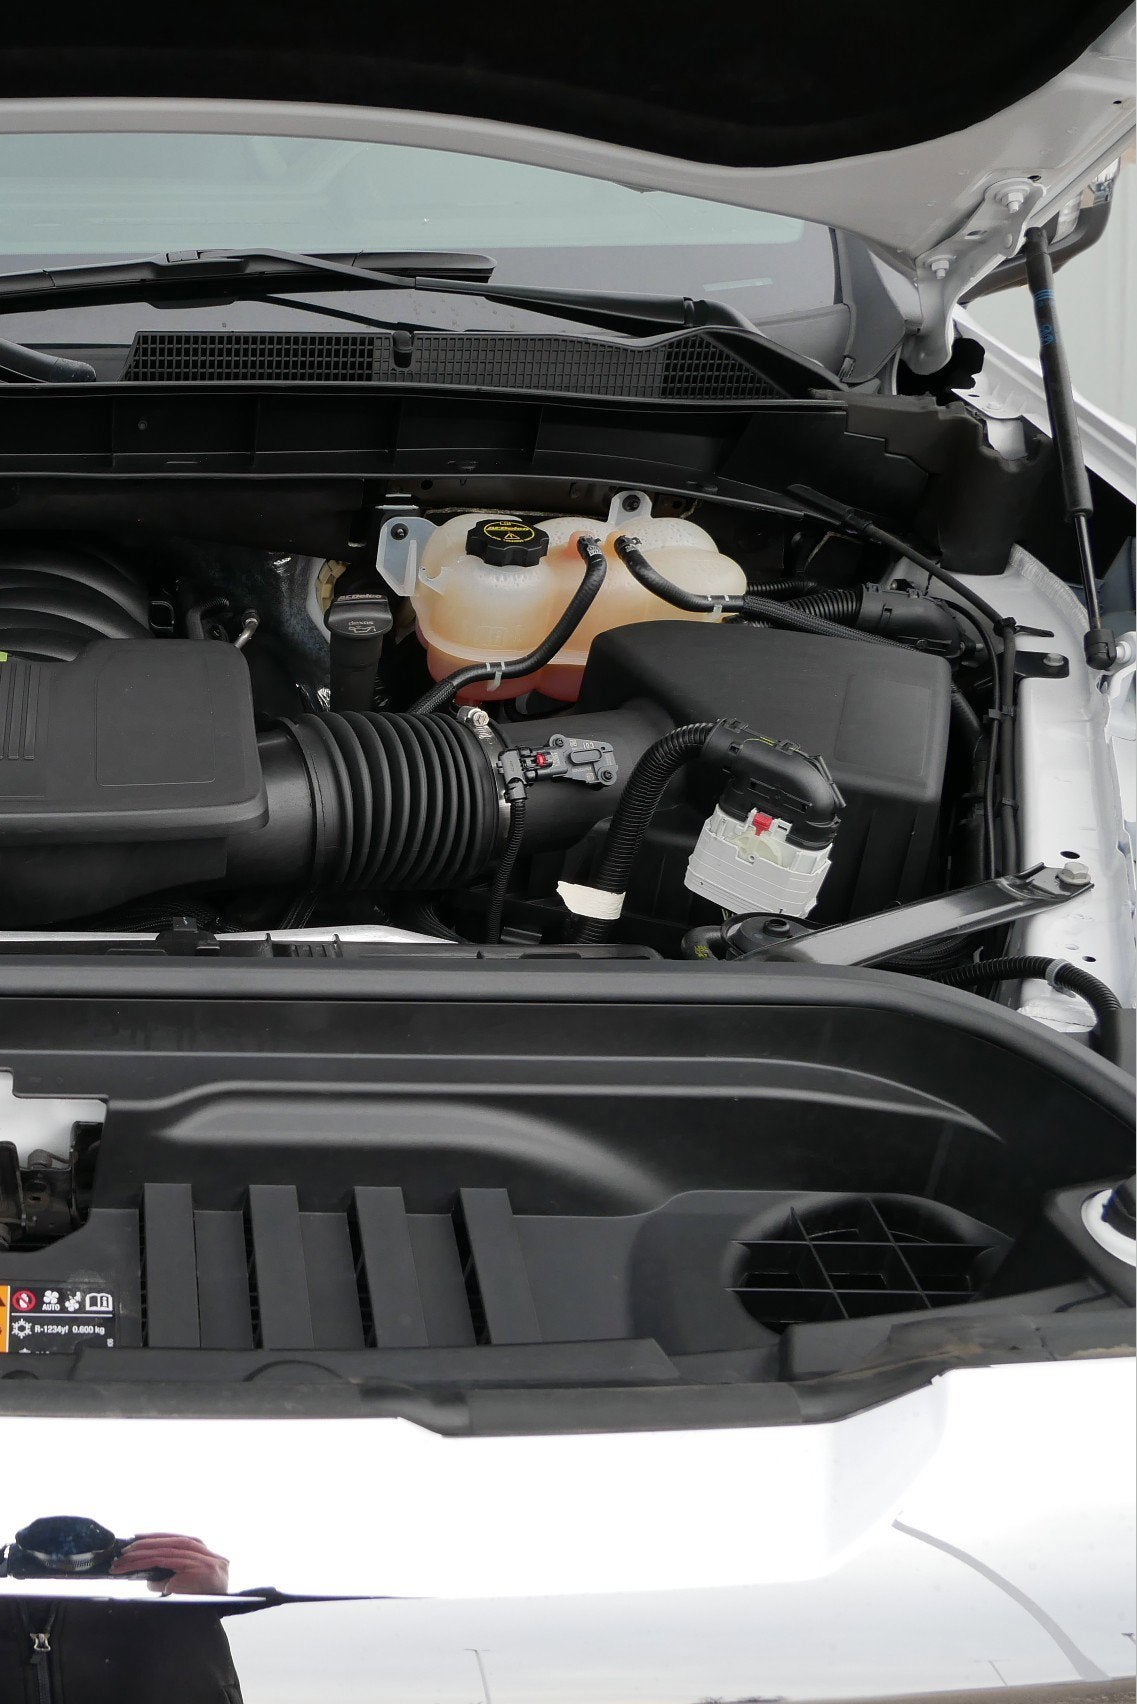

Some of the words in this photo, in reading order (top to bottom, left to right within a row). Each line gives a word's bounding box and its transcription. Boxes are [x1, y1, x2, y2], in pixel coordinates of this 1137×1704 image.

[42, 1303, 61, 1311] AUTO
[34, 1325, 69, 1336] R-1234yf
[94, 1326, 105, 1336] kg
